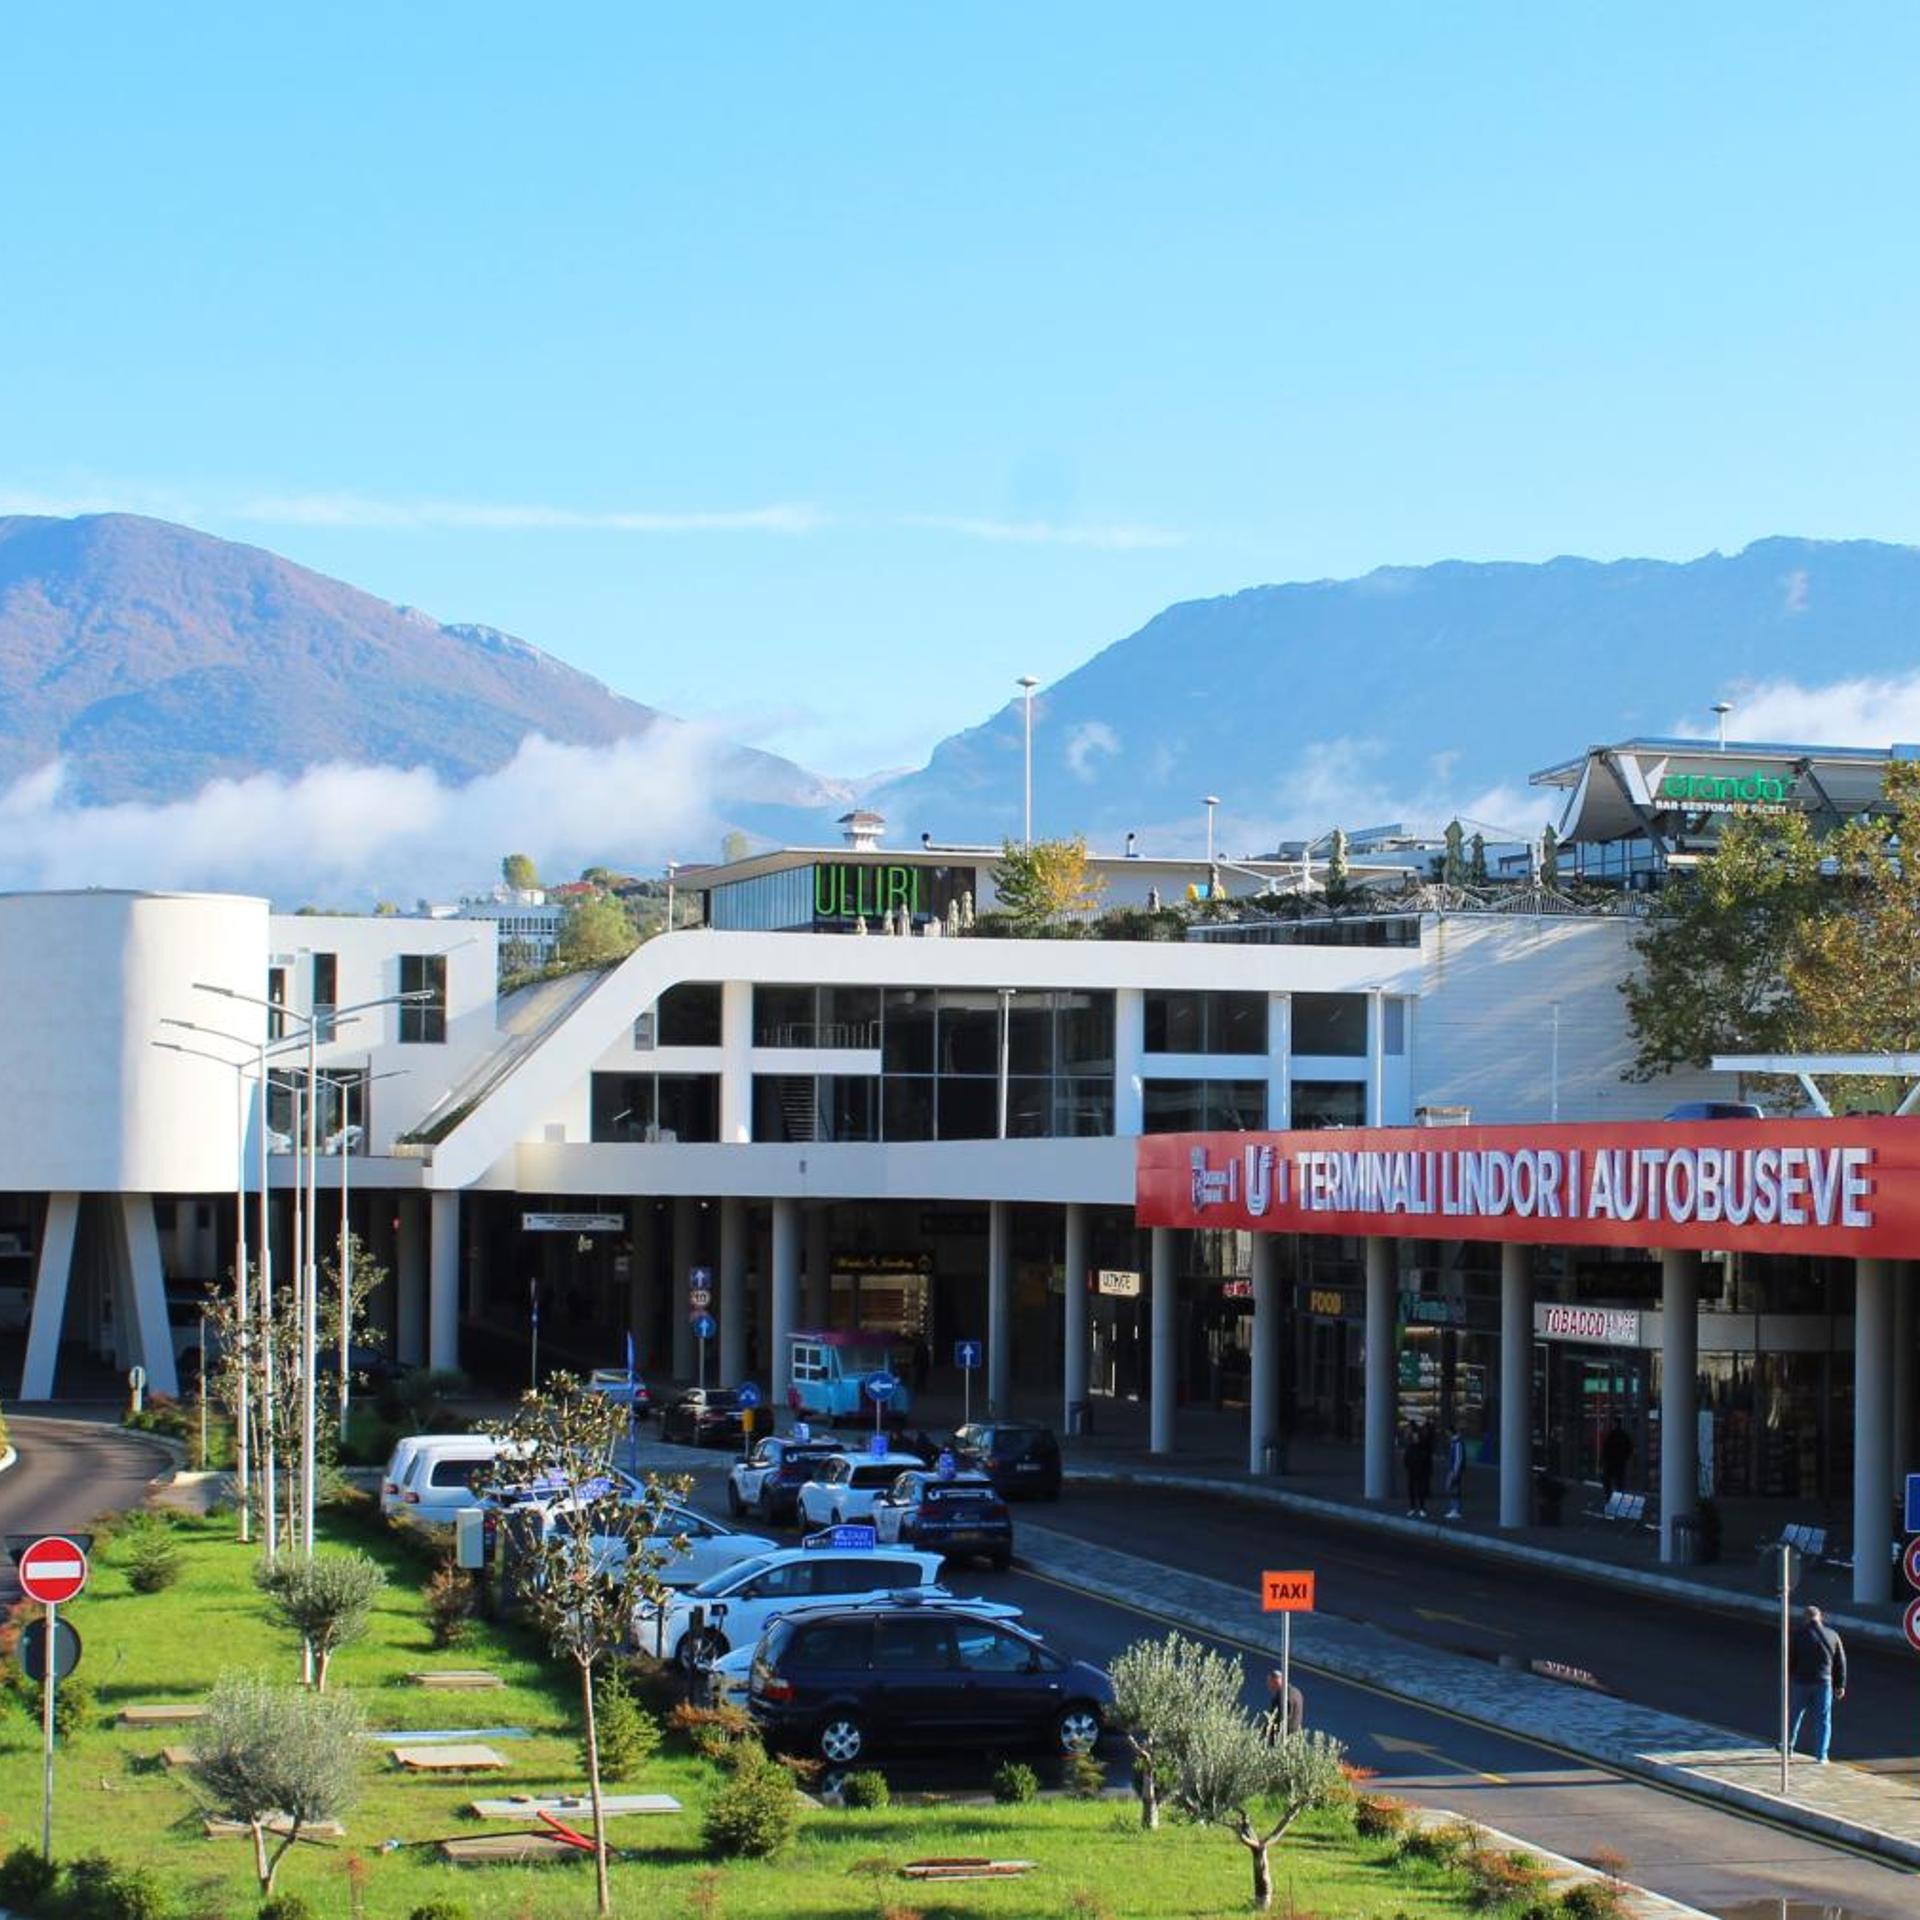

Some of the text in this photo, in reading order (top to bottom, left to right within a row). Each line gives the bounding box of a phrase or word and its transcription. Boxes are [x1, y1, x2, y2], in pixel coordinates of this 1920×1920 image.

[1297, 1151, 1436, 1214] TERMINALI
[1441, 1149, 1562, 1217] LINDOR
[1587, 1147, 1873, 1227] AUTOBUSEVE
[1545, 1308, 1607, 1337] TOBACCO
[1269, 1583, 1307, 1599] TAXI
